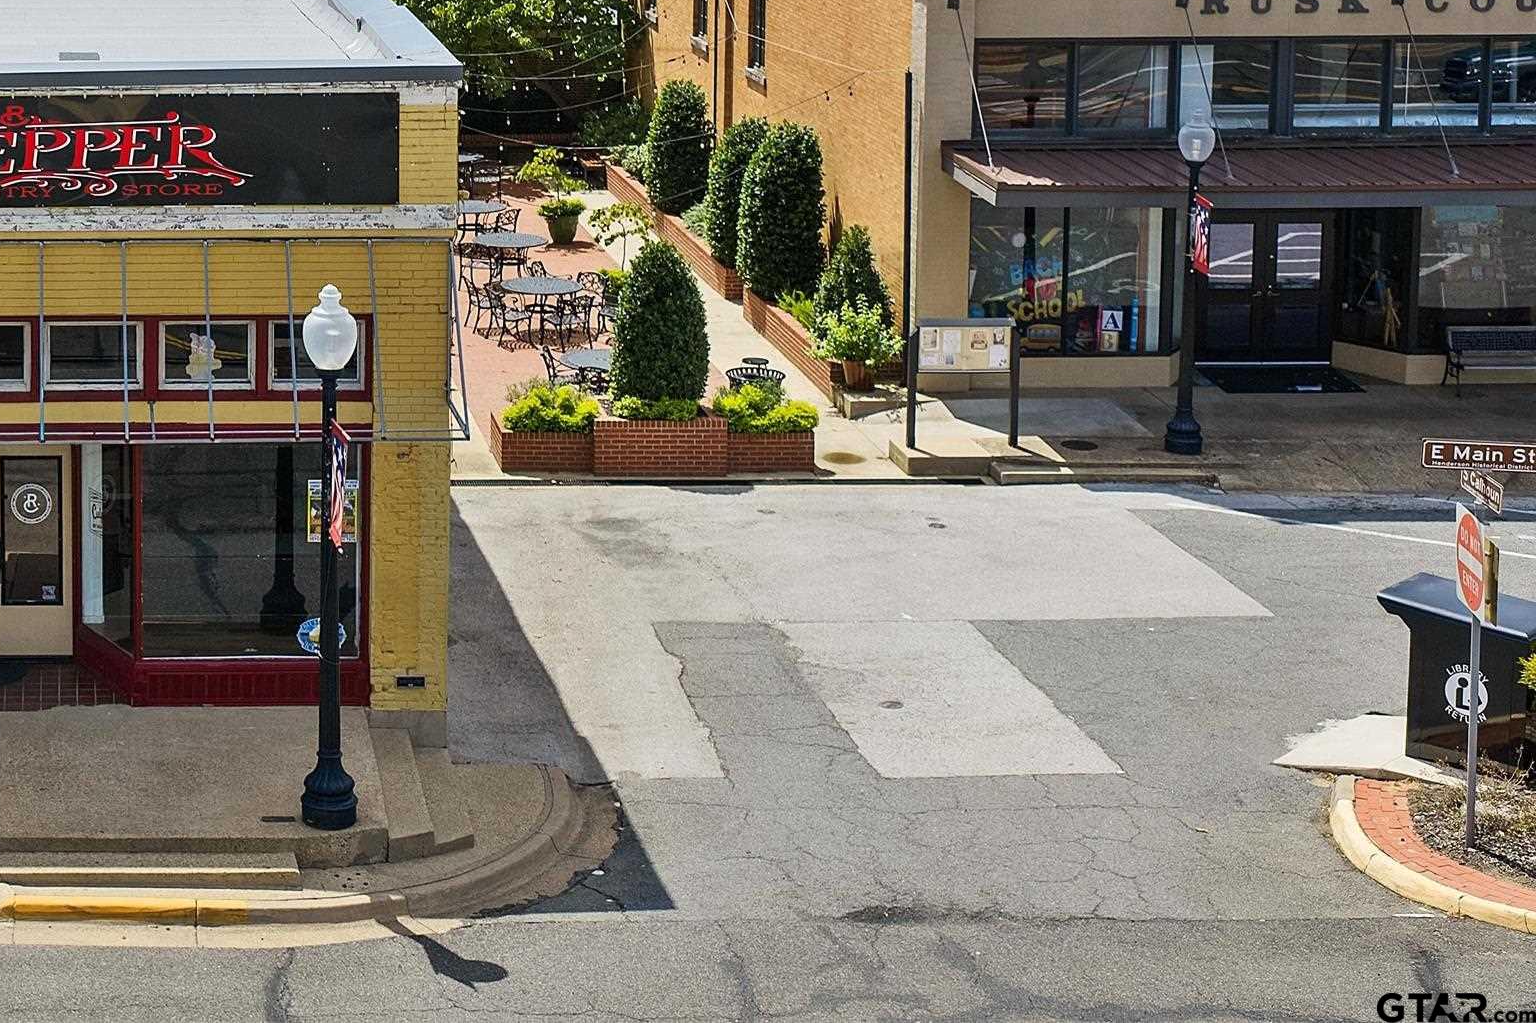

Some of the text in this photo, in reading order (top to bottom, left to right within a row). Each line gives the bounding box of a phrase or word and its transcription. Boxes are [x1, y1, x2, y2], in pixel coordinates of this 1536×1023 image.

[121, 183, 224, 198] STORE
[1431, 444, 1536, 464] E Main St
[1431, 460, 1471, 468] Henderson
[1472, 462, 1506, 470] Historical
[1470, 471, 1501, 505] Calhoun
[1462, 568, 1480, 597] ENTER
[1446, 664, 1490, 683] LIBRY
[1444, 705, 1488, 724] RETUN
